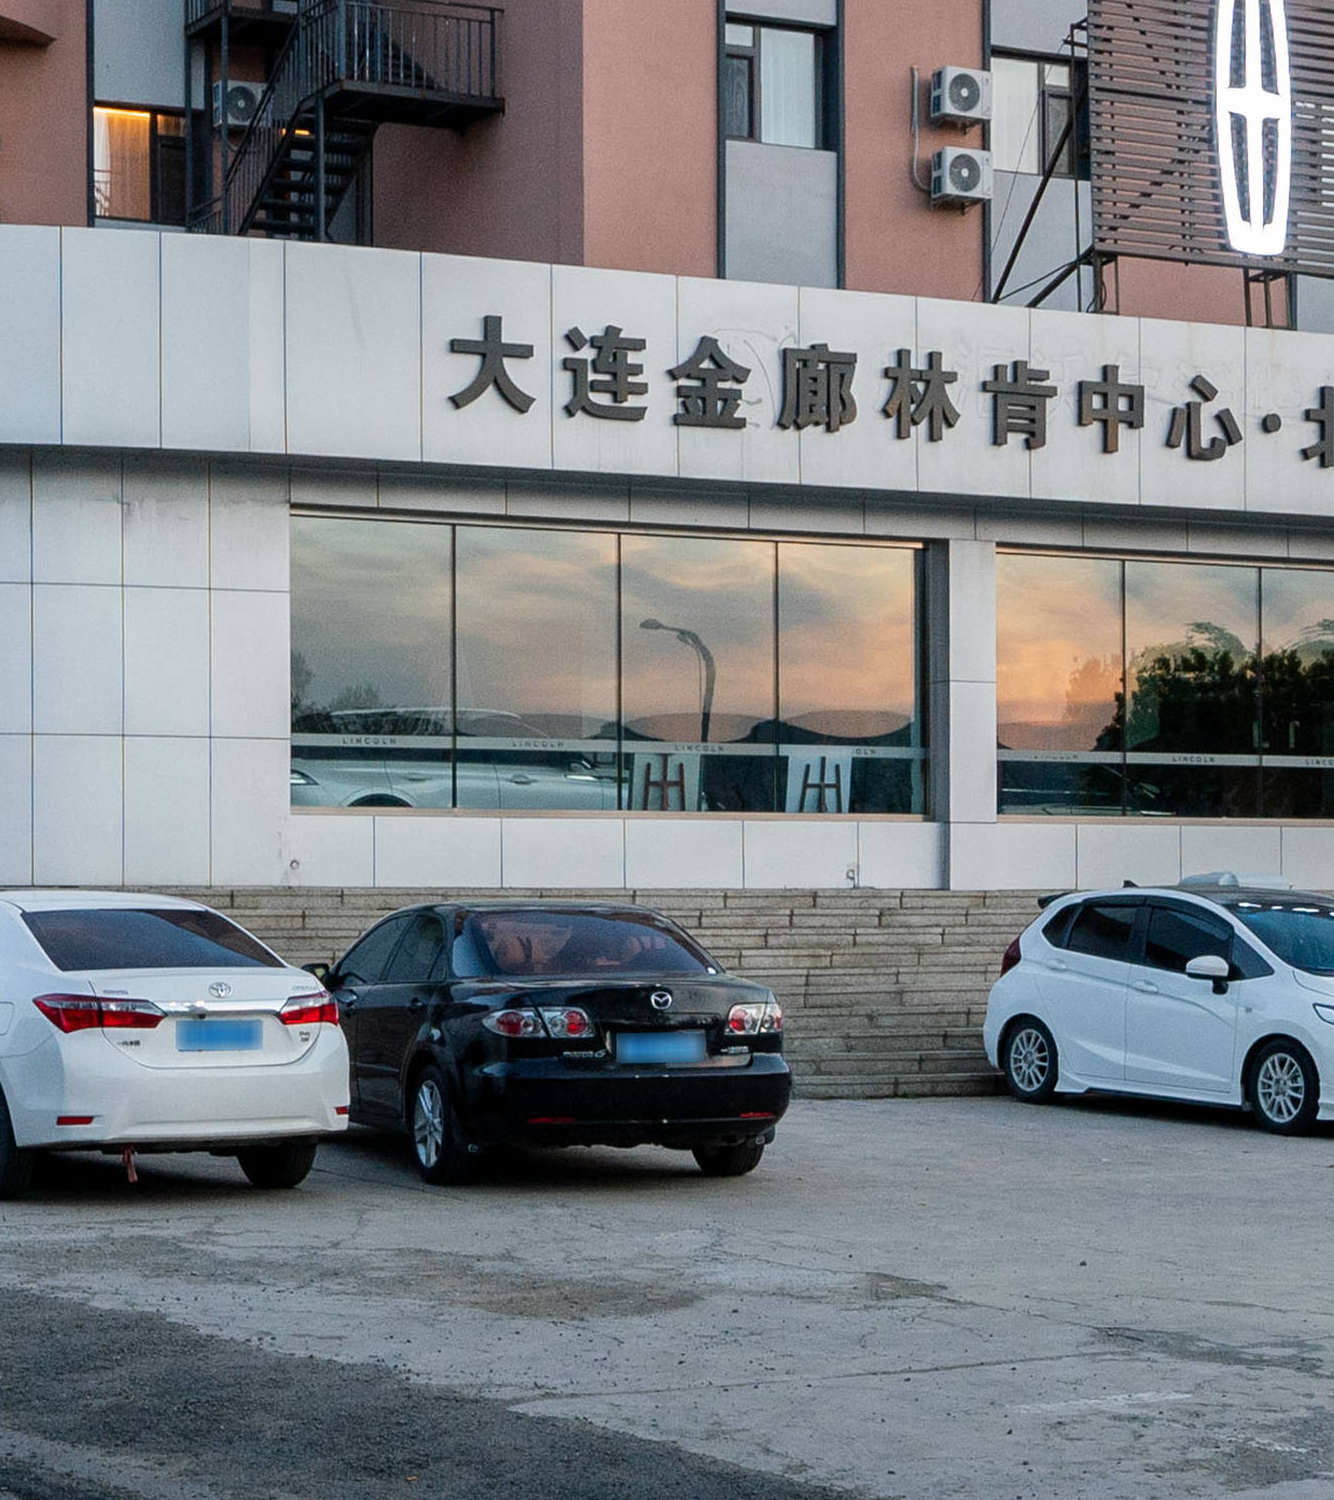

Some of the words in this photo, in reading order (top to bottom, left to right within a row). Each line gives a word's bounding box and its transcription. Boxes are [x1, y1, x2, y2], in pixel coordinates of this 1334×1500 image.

[341, 736, 397, 745] LINCOLN
[511, 740, 565, 748] LINCOLN
[1171, 755, 1216, 763] LINCOLN
